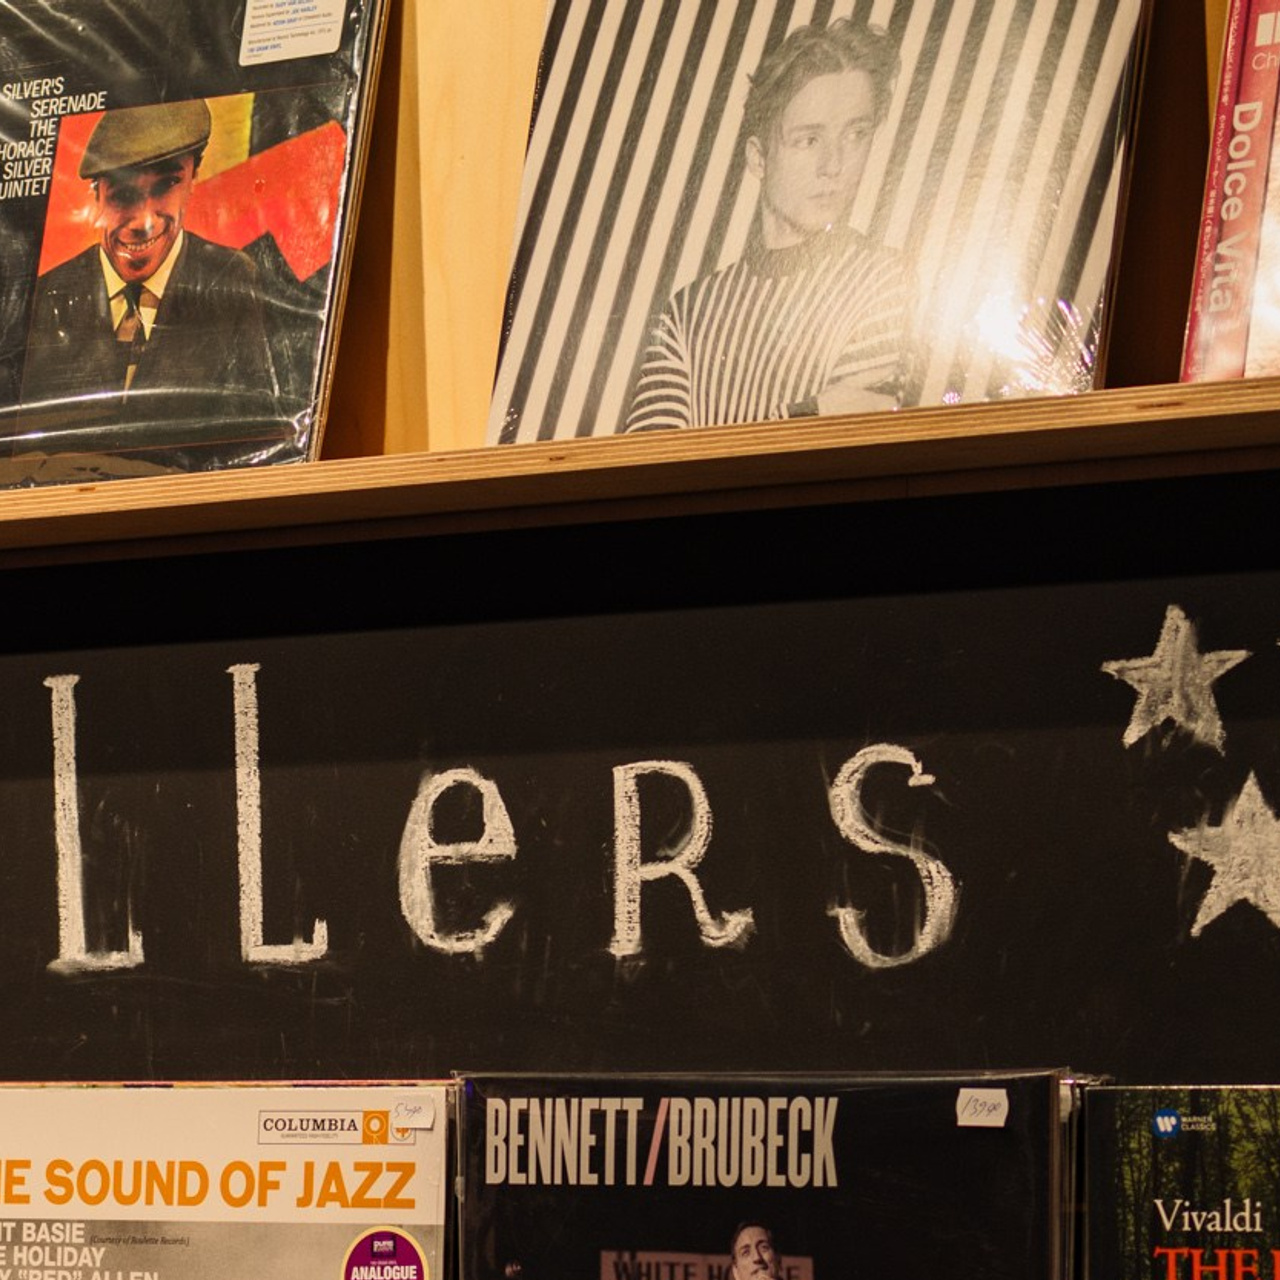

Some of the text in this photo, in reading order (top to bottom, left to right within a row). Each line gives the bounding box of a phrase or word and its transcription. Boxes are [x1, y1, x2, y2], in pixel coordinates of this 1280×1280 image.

[2, 76, 65, 101] SILVER'S
[30, 91, 108, 118] SERENADE
[29, 117, 59, 138] THE
[2, 157, 52, 180] SILVER
[1219, 100, 1263, 222] Dolce
[1208, 230, 1251, 314] Vita
[263, 1118, 358, 1132] COLUMBIA
[43, 1159, 210, 1207] SOUND
[219, 1160, 286, 1209] OF
[297, 1161, 416, 1209] JAZZ
[1154, 1198, 1263, 1232] Vivaldi
[22, 1223, 85, 1244] BASIE
[14, 1247, 106, 1267] HOLIDAY
[351, 1265, 417, 1280] ANALOGUE
